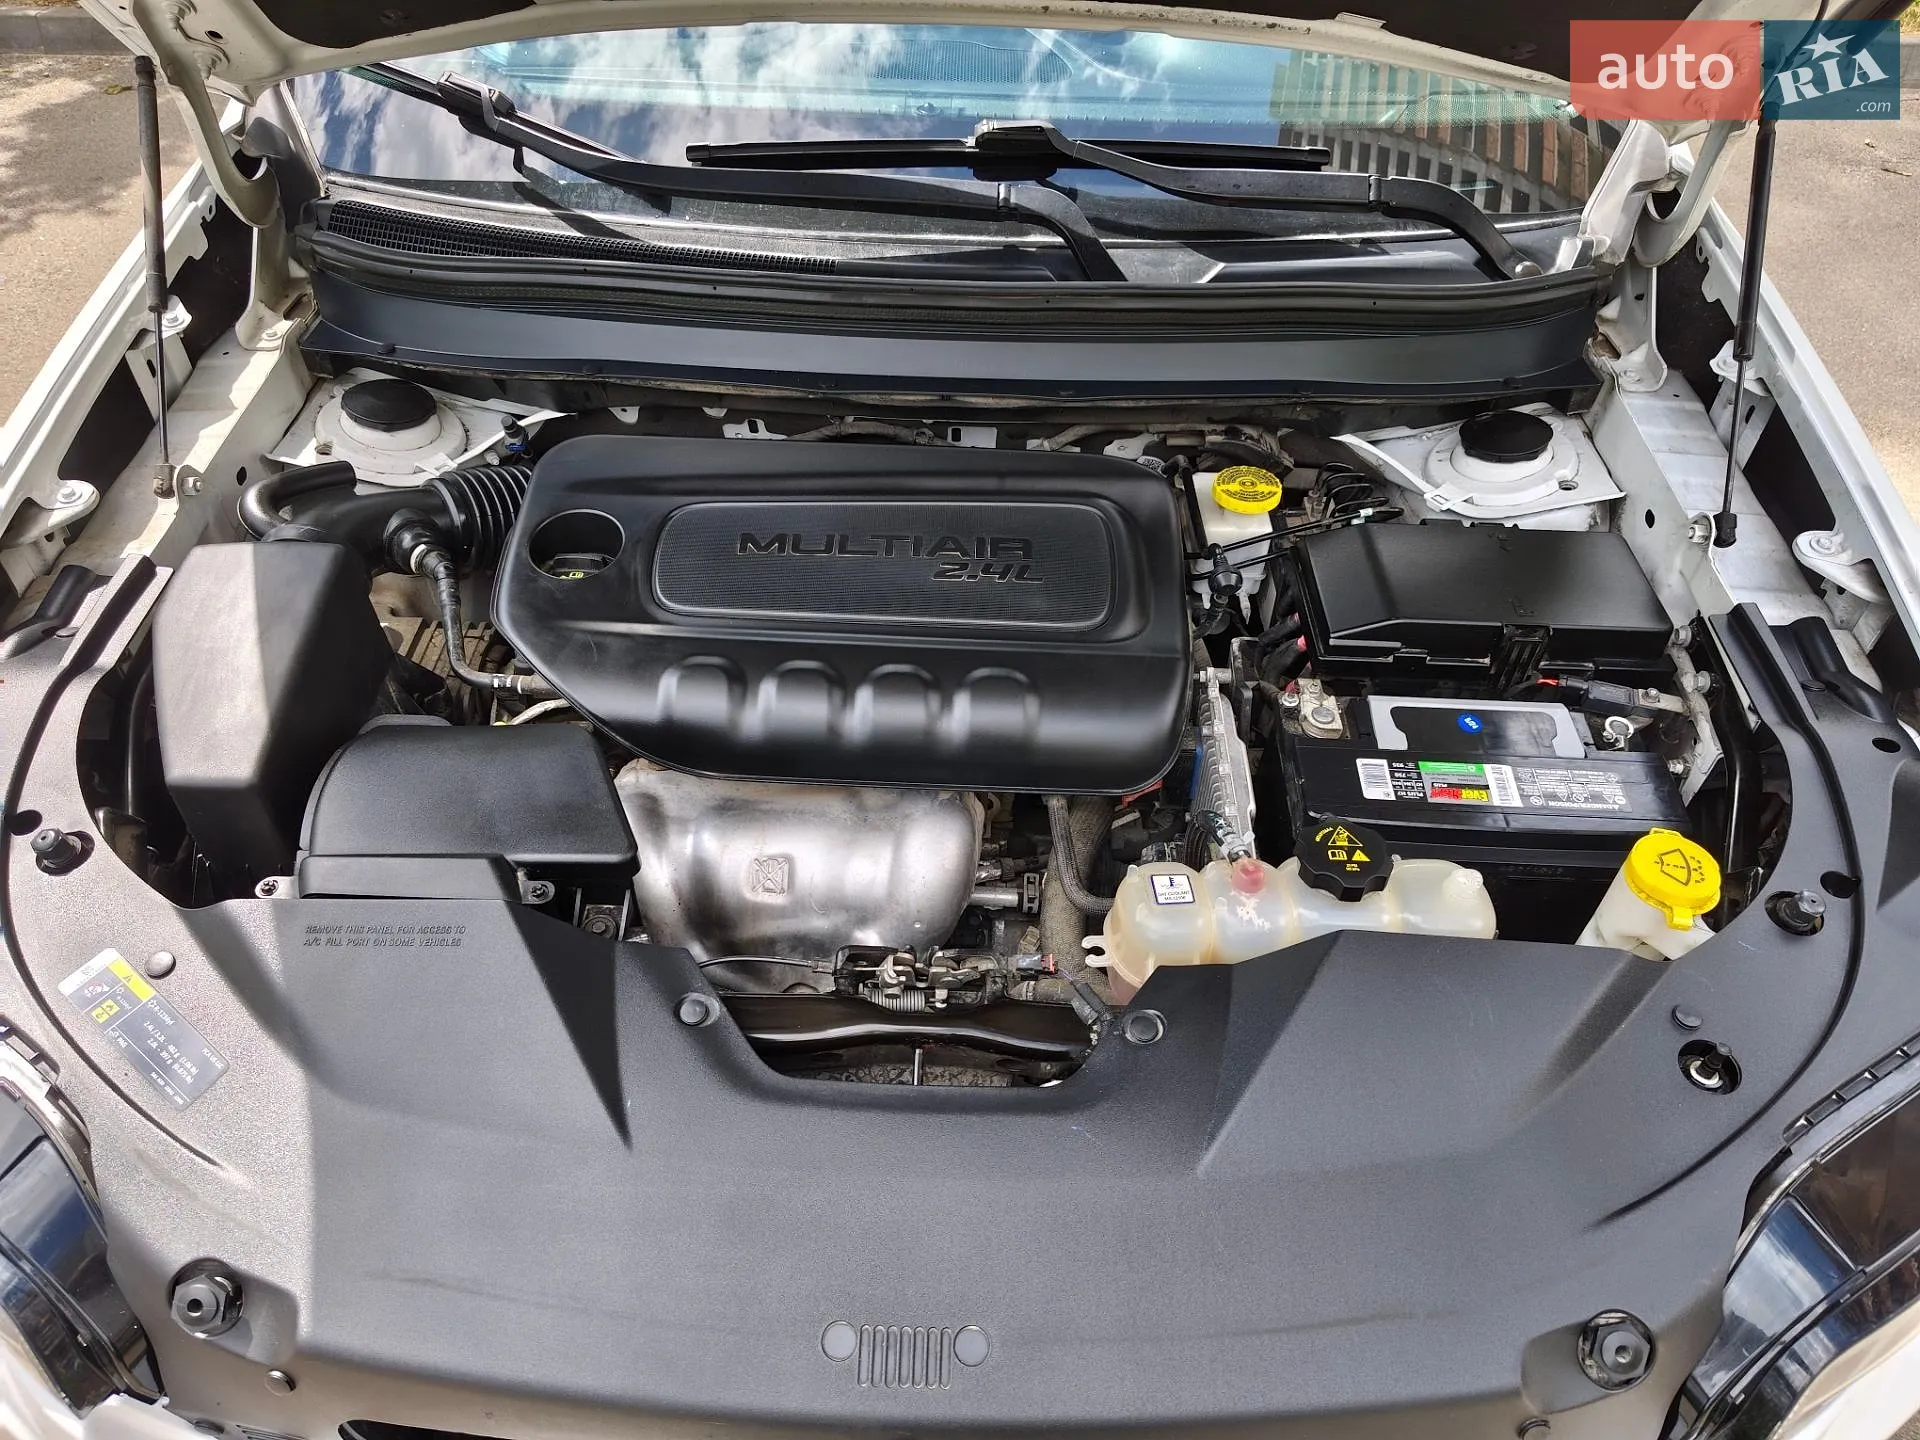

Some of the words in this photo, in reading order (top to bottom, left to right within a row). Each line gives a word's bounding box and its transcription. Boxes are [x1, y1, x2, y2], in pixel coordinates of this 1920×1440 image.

[738, 532, 1033, 560] MULTIAIR
[930, 561, 1045, 584] 2.4L
[304, 926, 343, 934] REMOVE
[344, 926, 365, 934] THIS
[366, 926, 394, 934] PANEL
[397, 926, 416, 934] FOR
[417, 926, 453, 934] ACCESS
[454, 926, 466, 934] TO
[304, 937, 322, 946] A/C
[325, 937, 344, 946] FILL
[346, 937, 369, 946] PORT
[373, 937, 388, 946] ON
[388, 937, 416, 946] SOME
[419, 937, 462, 946] VEHICLES
